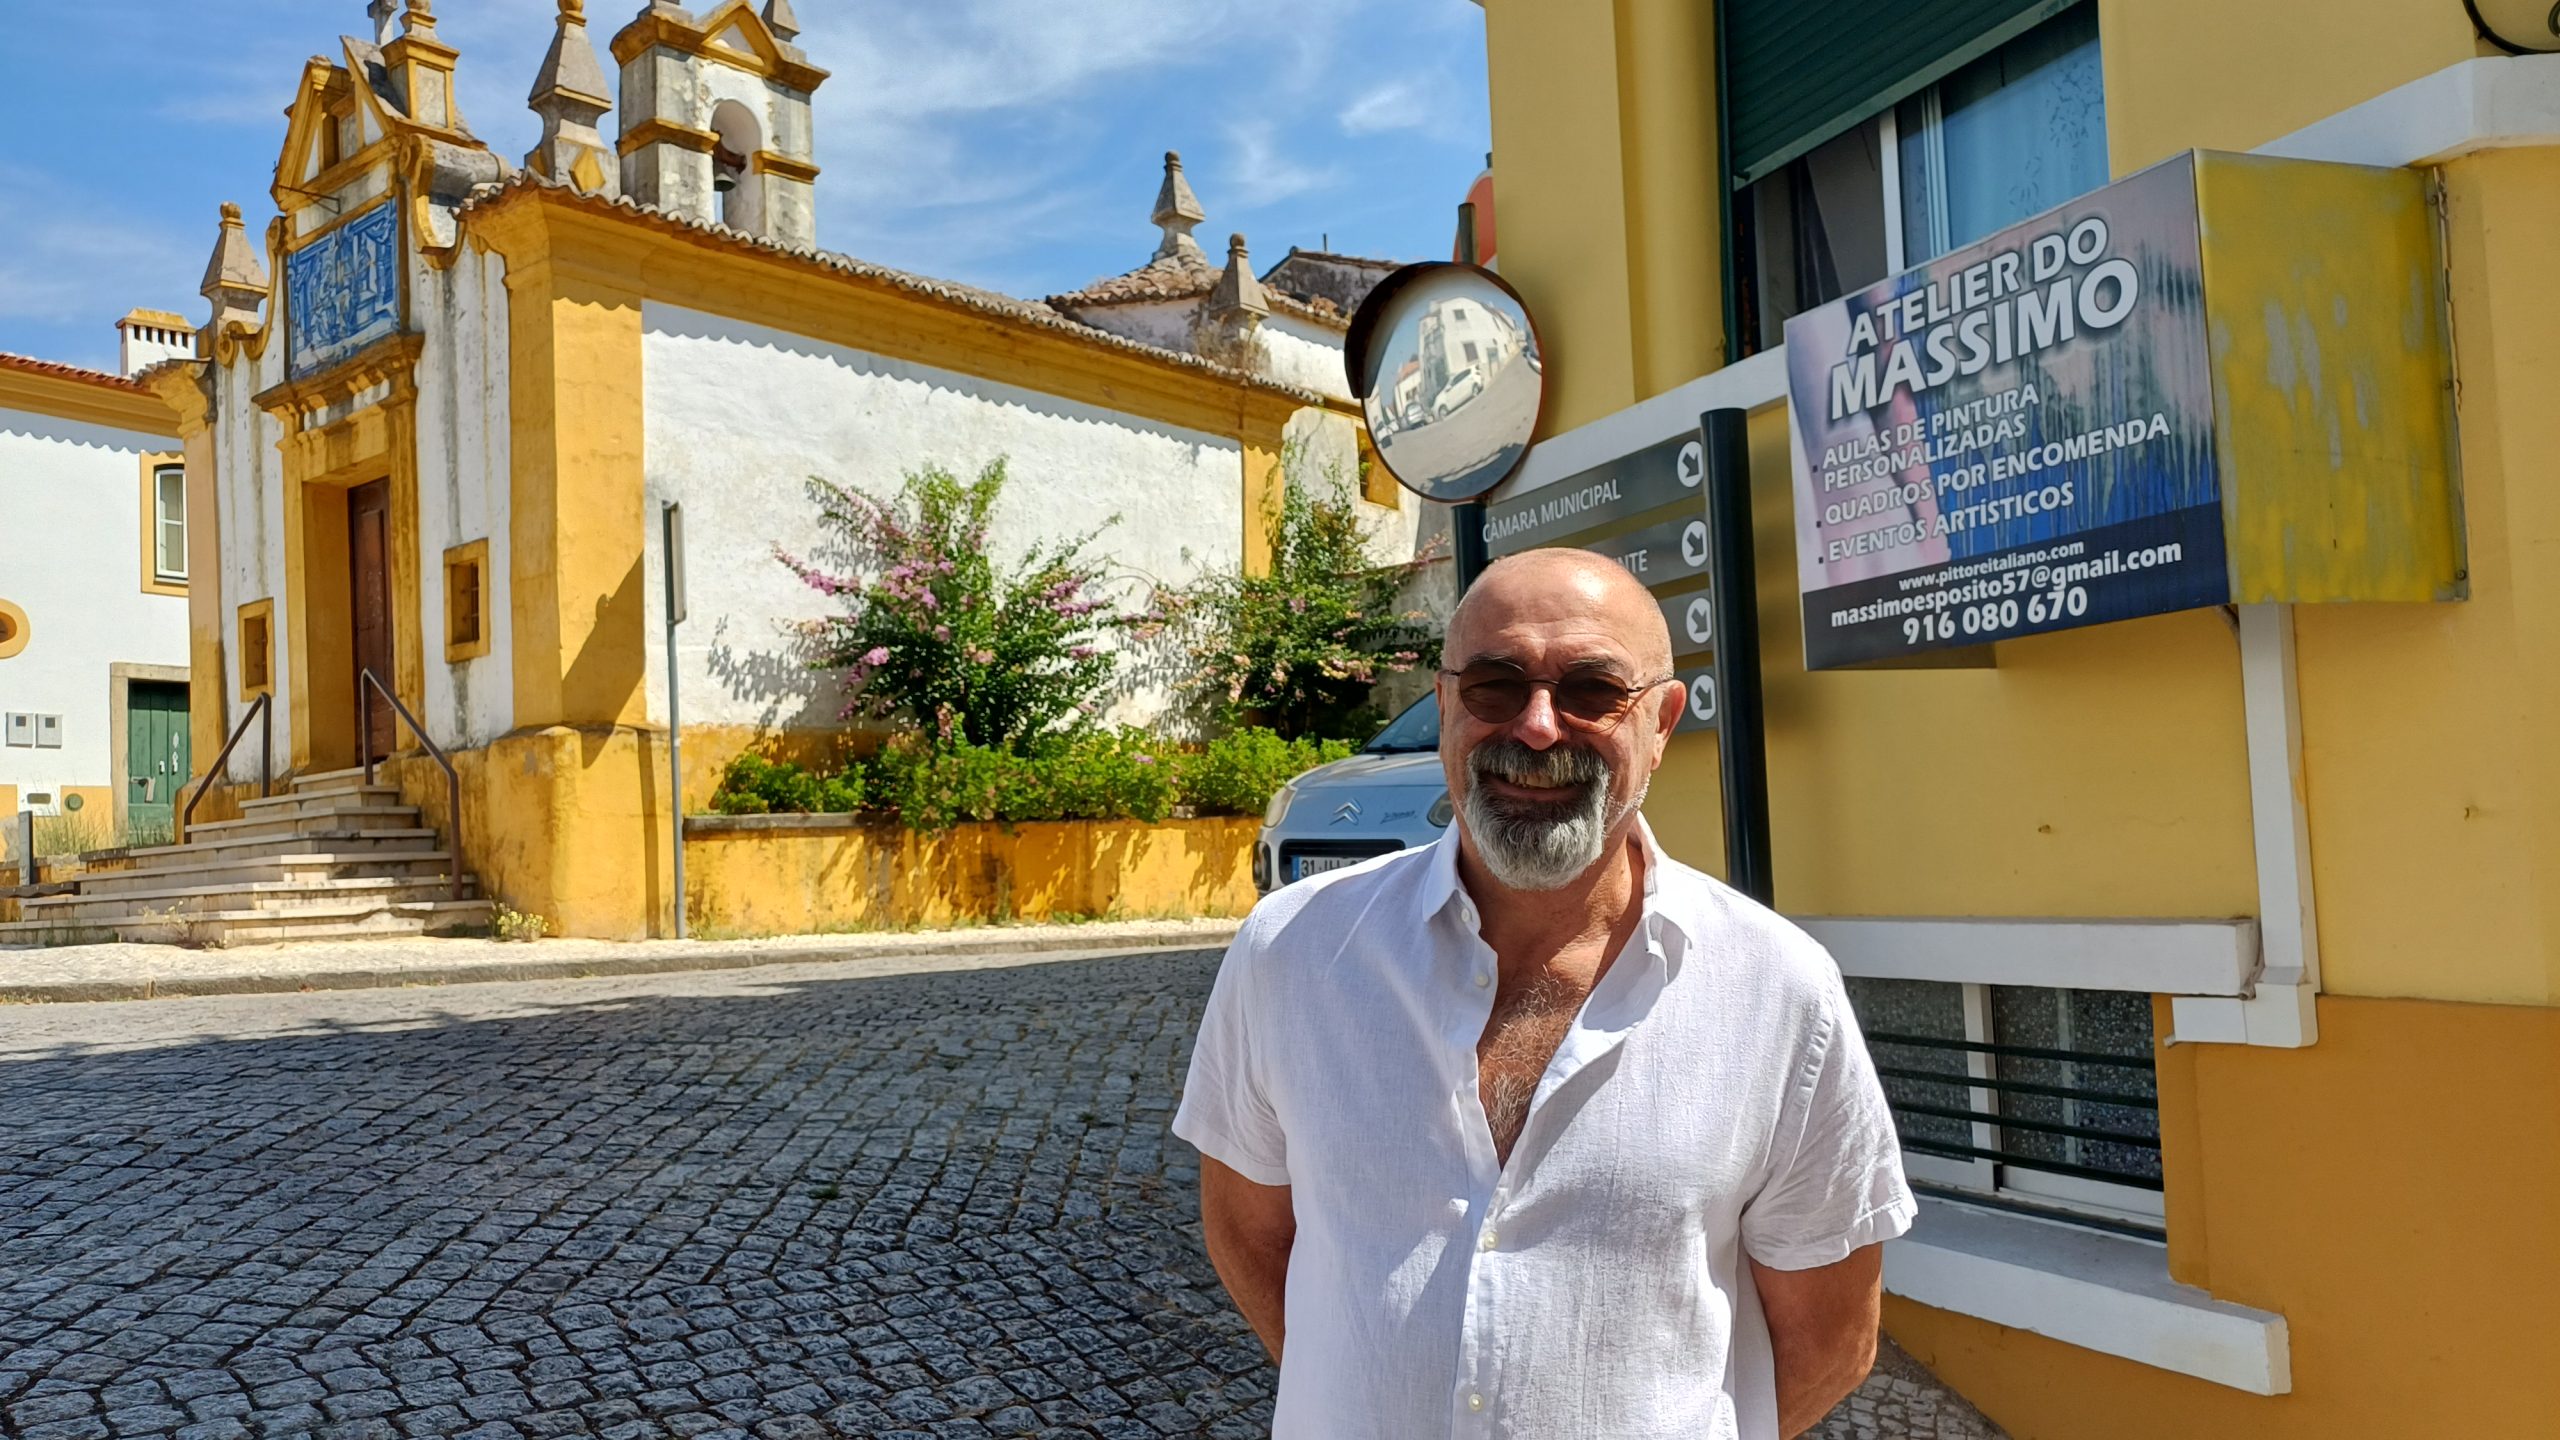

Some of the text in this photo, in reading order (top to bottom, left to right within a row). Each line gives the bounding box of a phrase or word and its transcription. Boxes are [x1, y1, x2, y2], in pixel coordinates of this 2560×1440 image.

[1846, 216, 2109, 356] ATELIER DO
[1831, 257, 2139, 421] MASSIMO
[1822, 383, 2040, 470] AULAS DE PINTURA
[1824, 412, 2027, 492] PERSONALIZADAS
[1825, 412, 2171, 525] QUADROS POR ENCOMENDA
[1482, 478, 1622, 543] CÂMARA MUNICIPAL
[1828, 480, 2075, 562] EVENTOS ARTÍSTICOS
[1615, 549, 1649, 573] NTE
[1831, 541, 2182, 628] massimoesposito57@gmail.com
[1899, 540, 2085, 591] www.pittoreitaliano.com
[1902, 585, 2088, 646] 916 080 670
